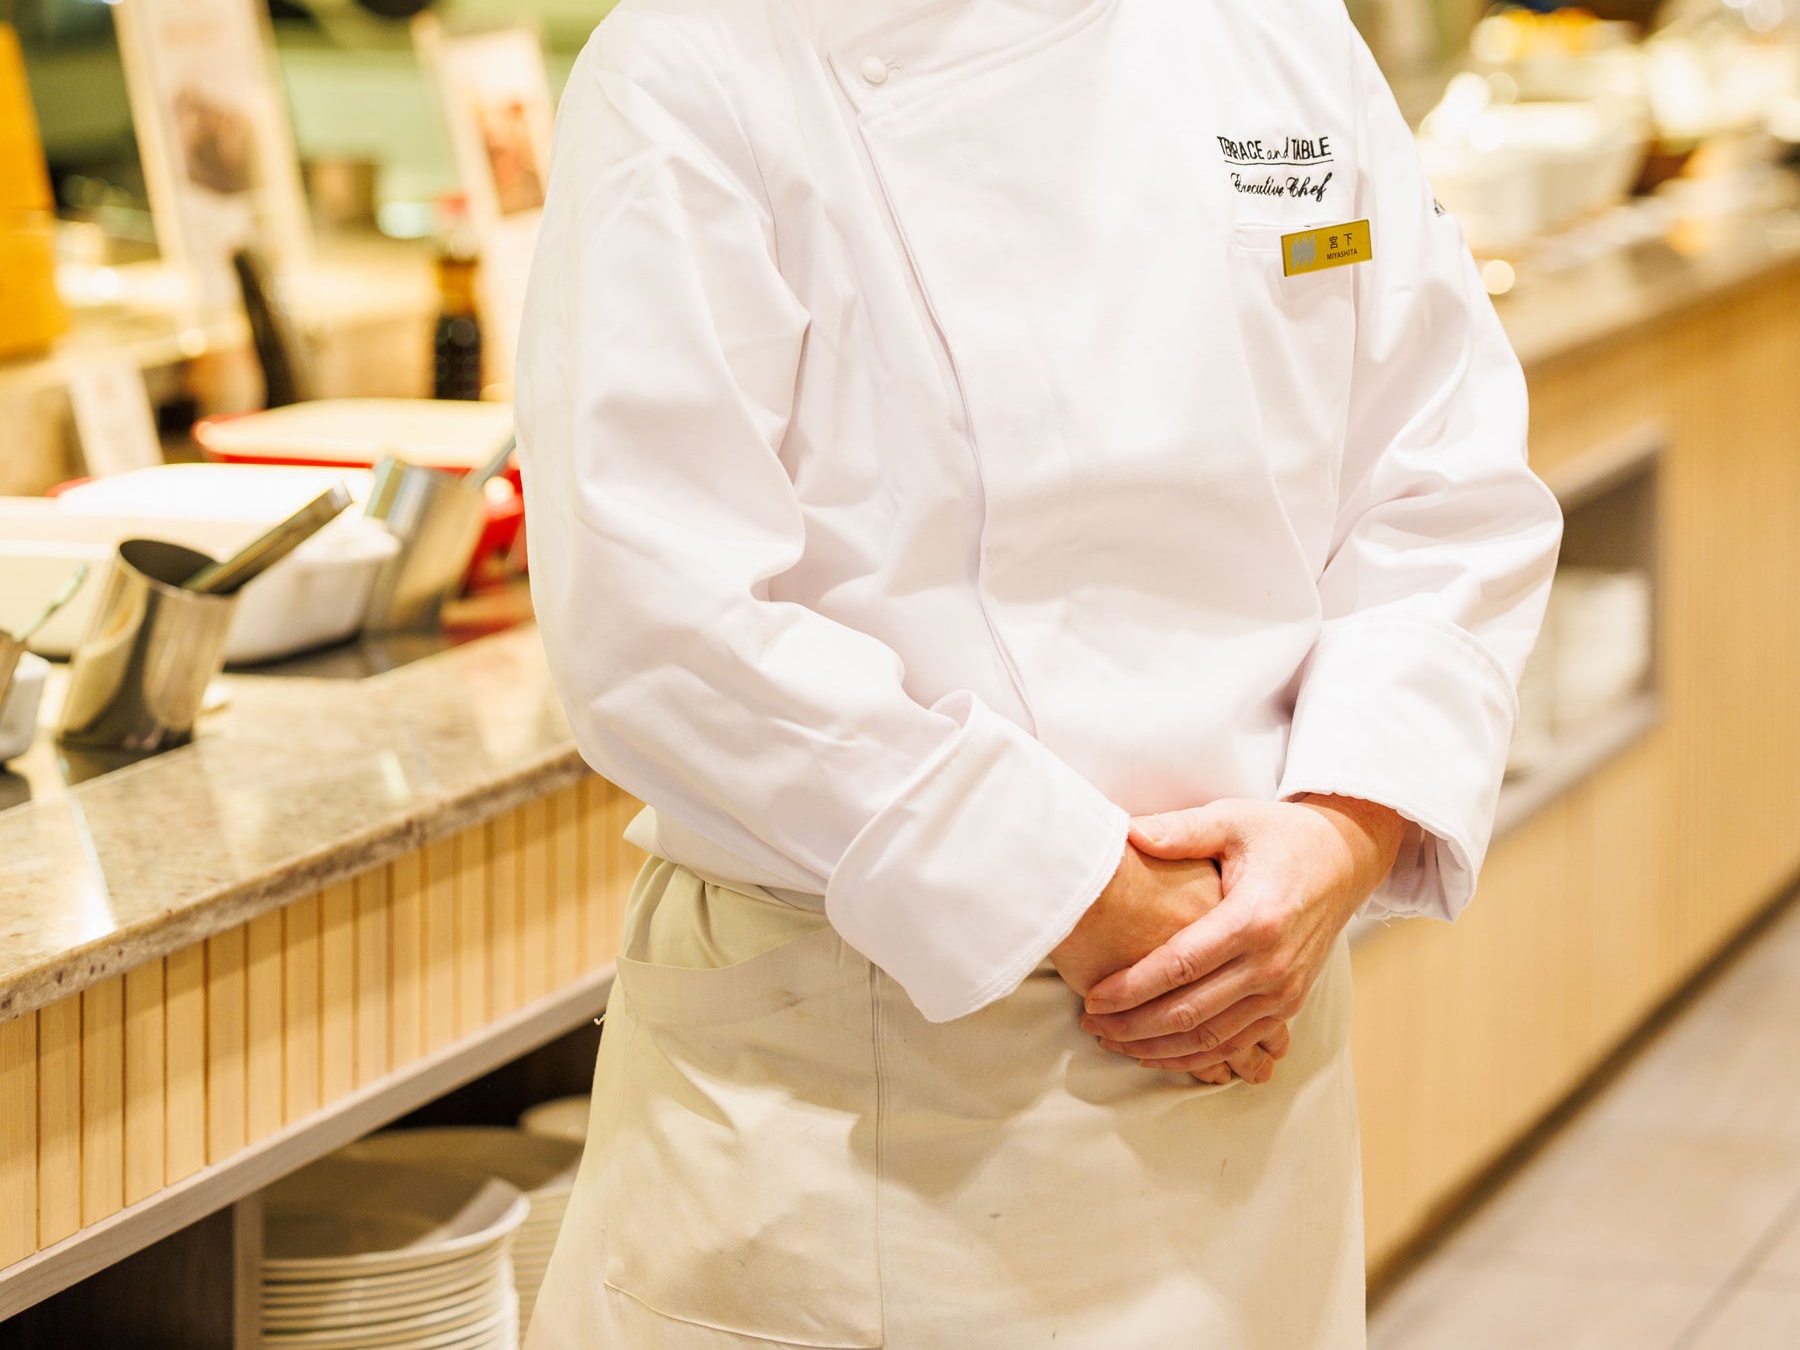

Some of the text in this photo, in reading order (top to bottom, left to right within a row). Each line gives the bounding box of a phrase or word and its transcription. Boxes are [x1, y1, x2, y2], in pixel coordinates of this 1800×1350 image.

[1266, 137, 1289, 160] and
[1291, 136, 1332, 160] TABLE
[1230, 172, 1333, 202] Executive Chef
[1328, 232, 1353, 249] 宮下
[1326, 248, 1358, 260] MIYASHITA
